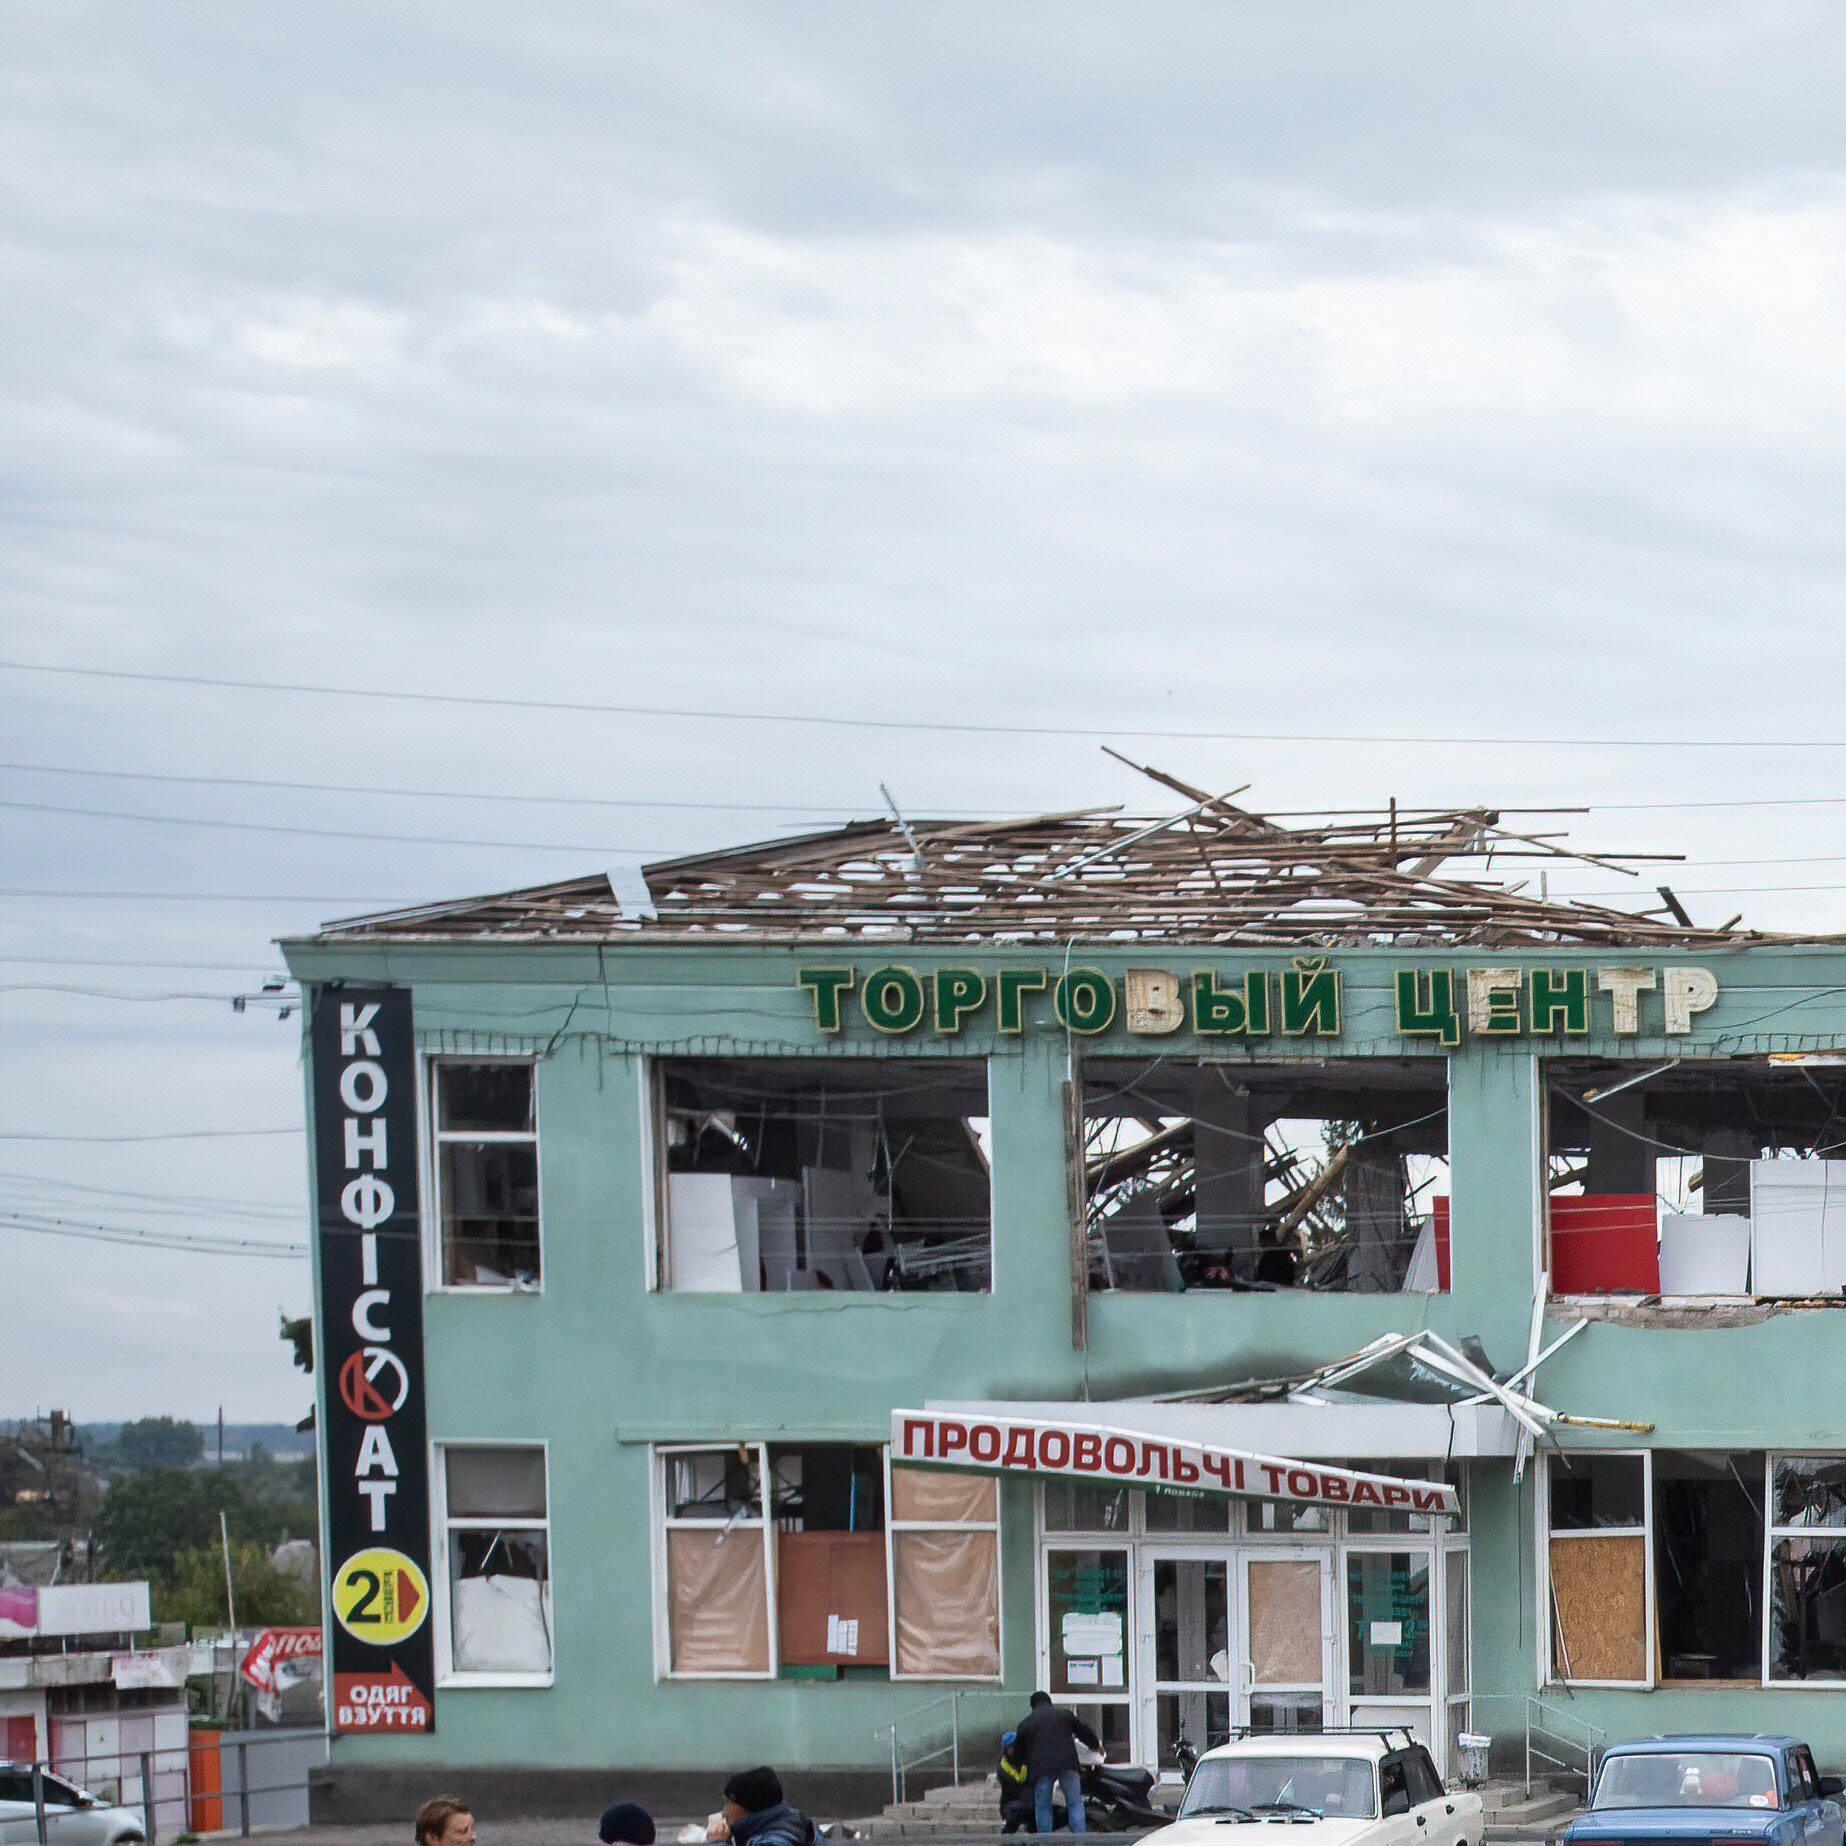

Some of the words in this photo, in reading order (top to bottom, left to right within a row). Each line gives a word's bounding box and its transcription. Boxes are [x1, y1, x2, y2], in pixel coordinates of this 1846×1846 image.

[799, 955, 1342, 1036] ТОРГОВЫЙ
[1395, 965, 1719, 1046] ЦЕНТР
[903, 1418, 1245, 1491] ПРОДОВОЛЬЧІ
[1260, 1466, 1445, 1512] ТОВАРИ
[345, 1569, 382, 1623] 2
[339, 1706, 426, 1725] ВЗУТТЯ
[350, 1685, 413, 1707] ОДЯГ
